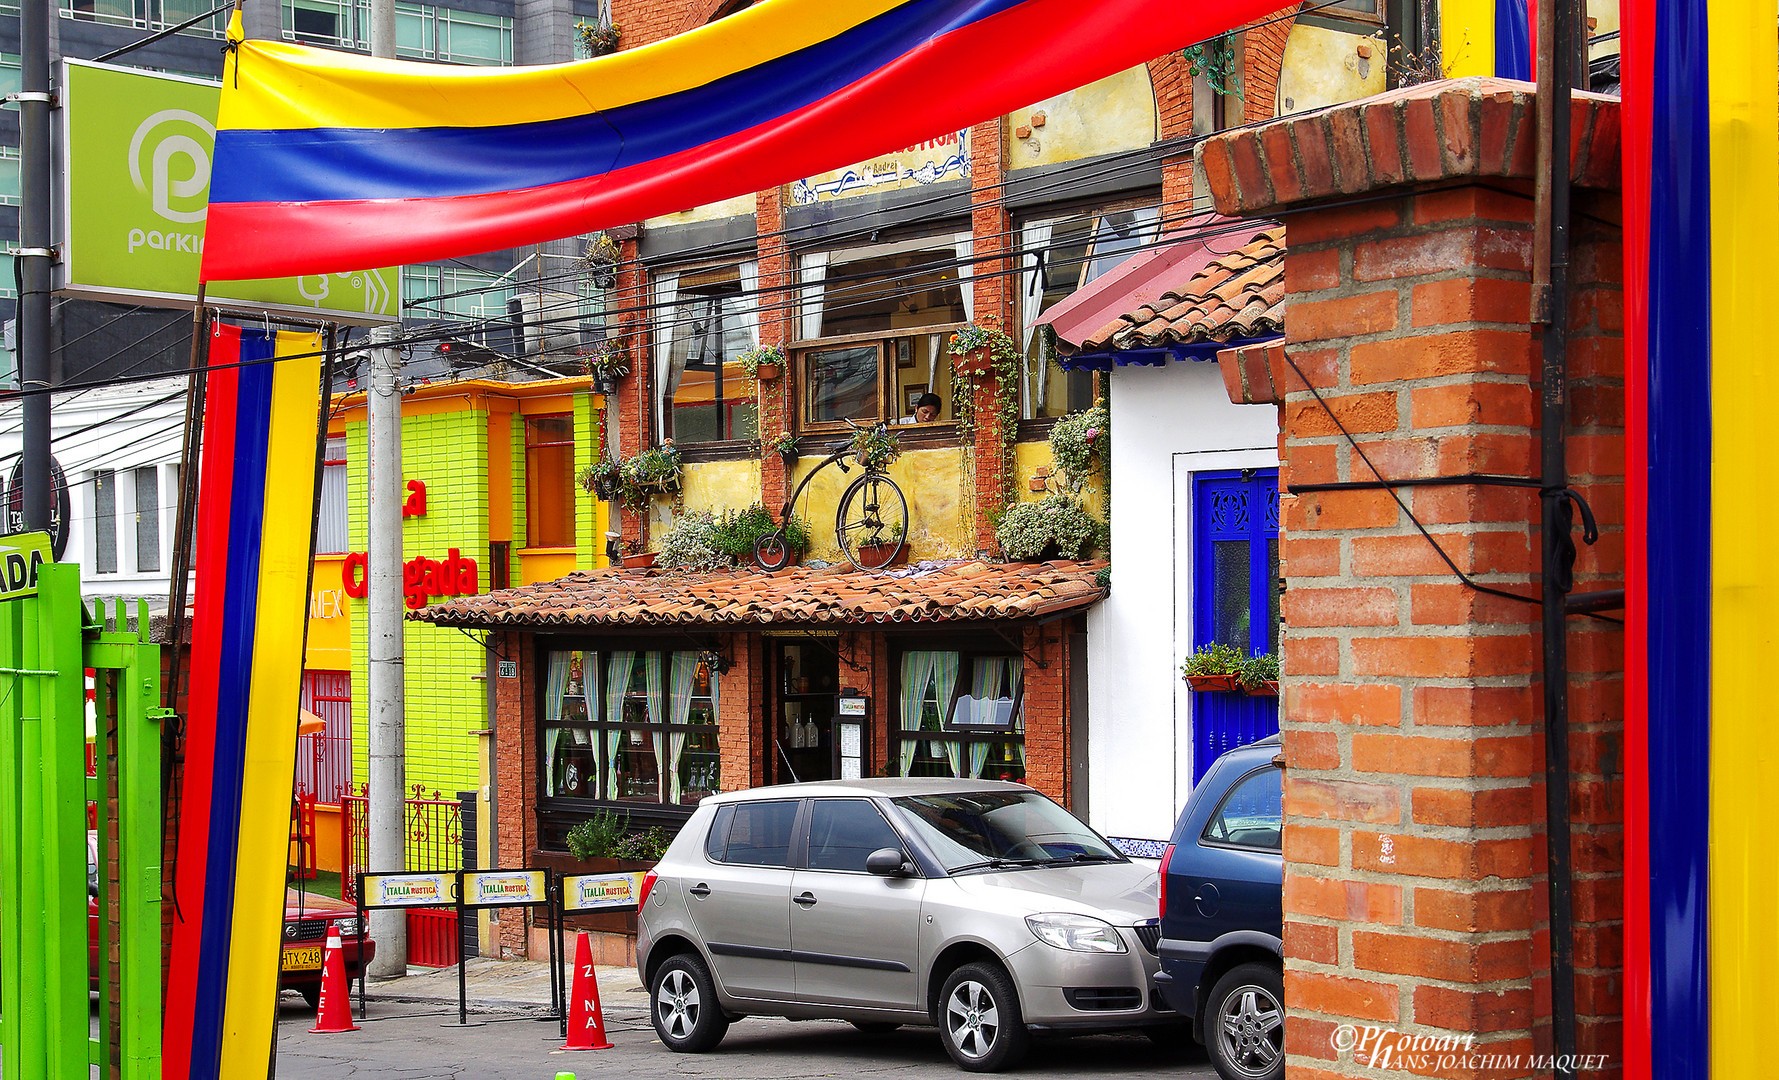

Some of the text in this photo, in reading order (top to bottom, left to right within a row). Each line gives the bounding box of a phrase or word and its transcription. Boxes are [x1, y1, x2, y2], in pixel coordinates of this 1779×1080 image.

[402, 479, 427, 517] a
[386, 886, 437, 896] ITALIA RUSTICA
[483, 884, 528, 894] ITALIA RUSTICA
[584, 886, 630, 898] ITALIA RUSTICA
[302, 951, 320, 964] 248
[318, 950, 332, 1024] VALET
